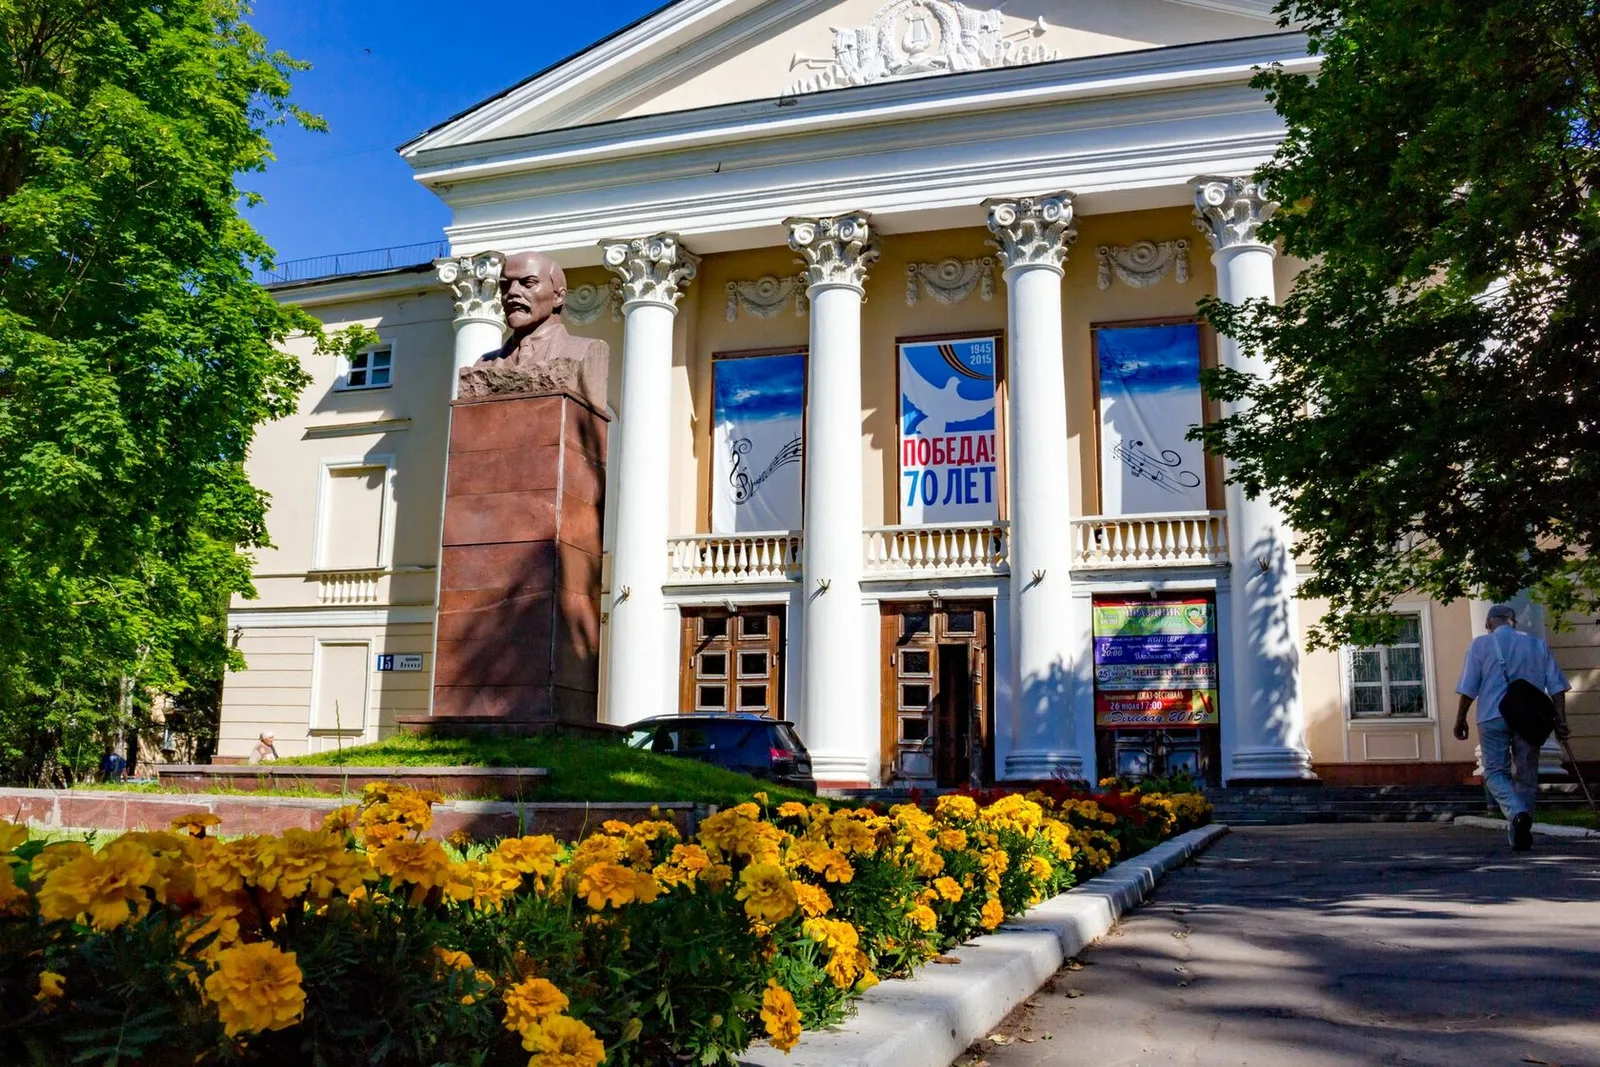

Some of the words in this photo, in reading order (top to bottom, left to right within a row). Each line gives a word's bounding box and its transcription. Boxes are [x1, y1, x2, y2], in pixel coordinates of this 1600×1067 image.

[970, 344, 992, 354] 1945
[970, 354, 992, 365] 2015
[903, 434, 996, 467] ПОБЕДА!
[903, 469, 939, 507] 70
[942, 466, 996, 506] ЛЕТ
[1126, 607, 1181, 618] ПРАЗДНИК
[1147, 635, 1184, 643] КОНЦЕРТ
[1101, 643, 1111, 651] 17
[379, 656, 392, 670] 15
[1098, 670, 1108, 678] 25
[1132, 667, 1215, 677] МЕНЕСТРЕЛЬНИК
[1110, 702, 1120, 710] 26
[1140, 701, 1163, 710] 17:00
